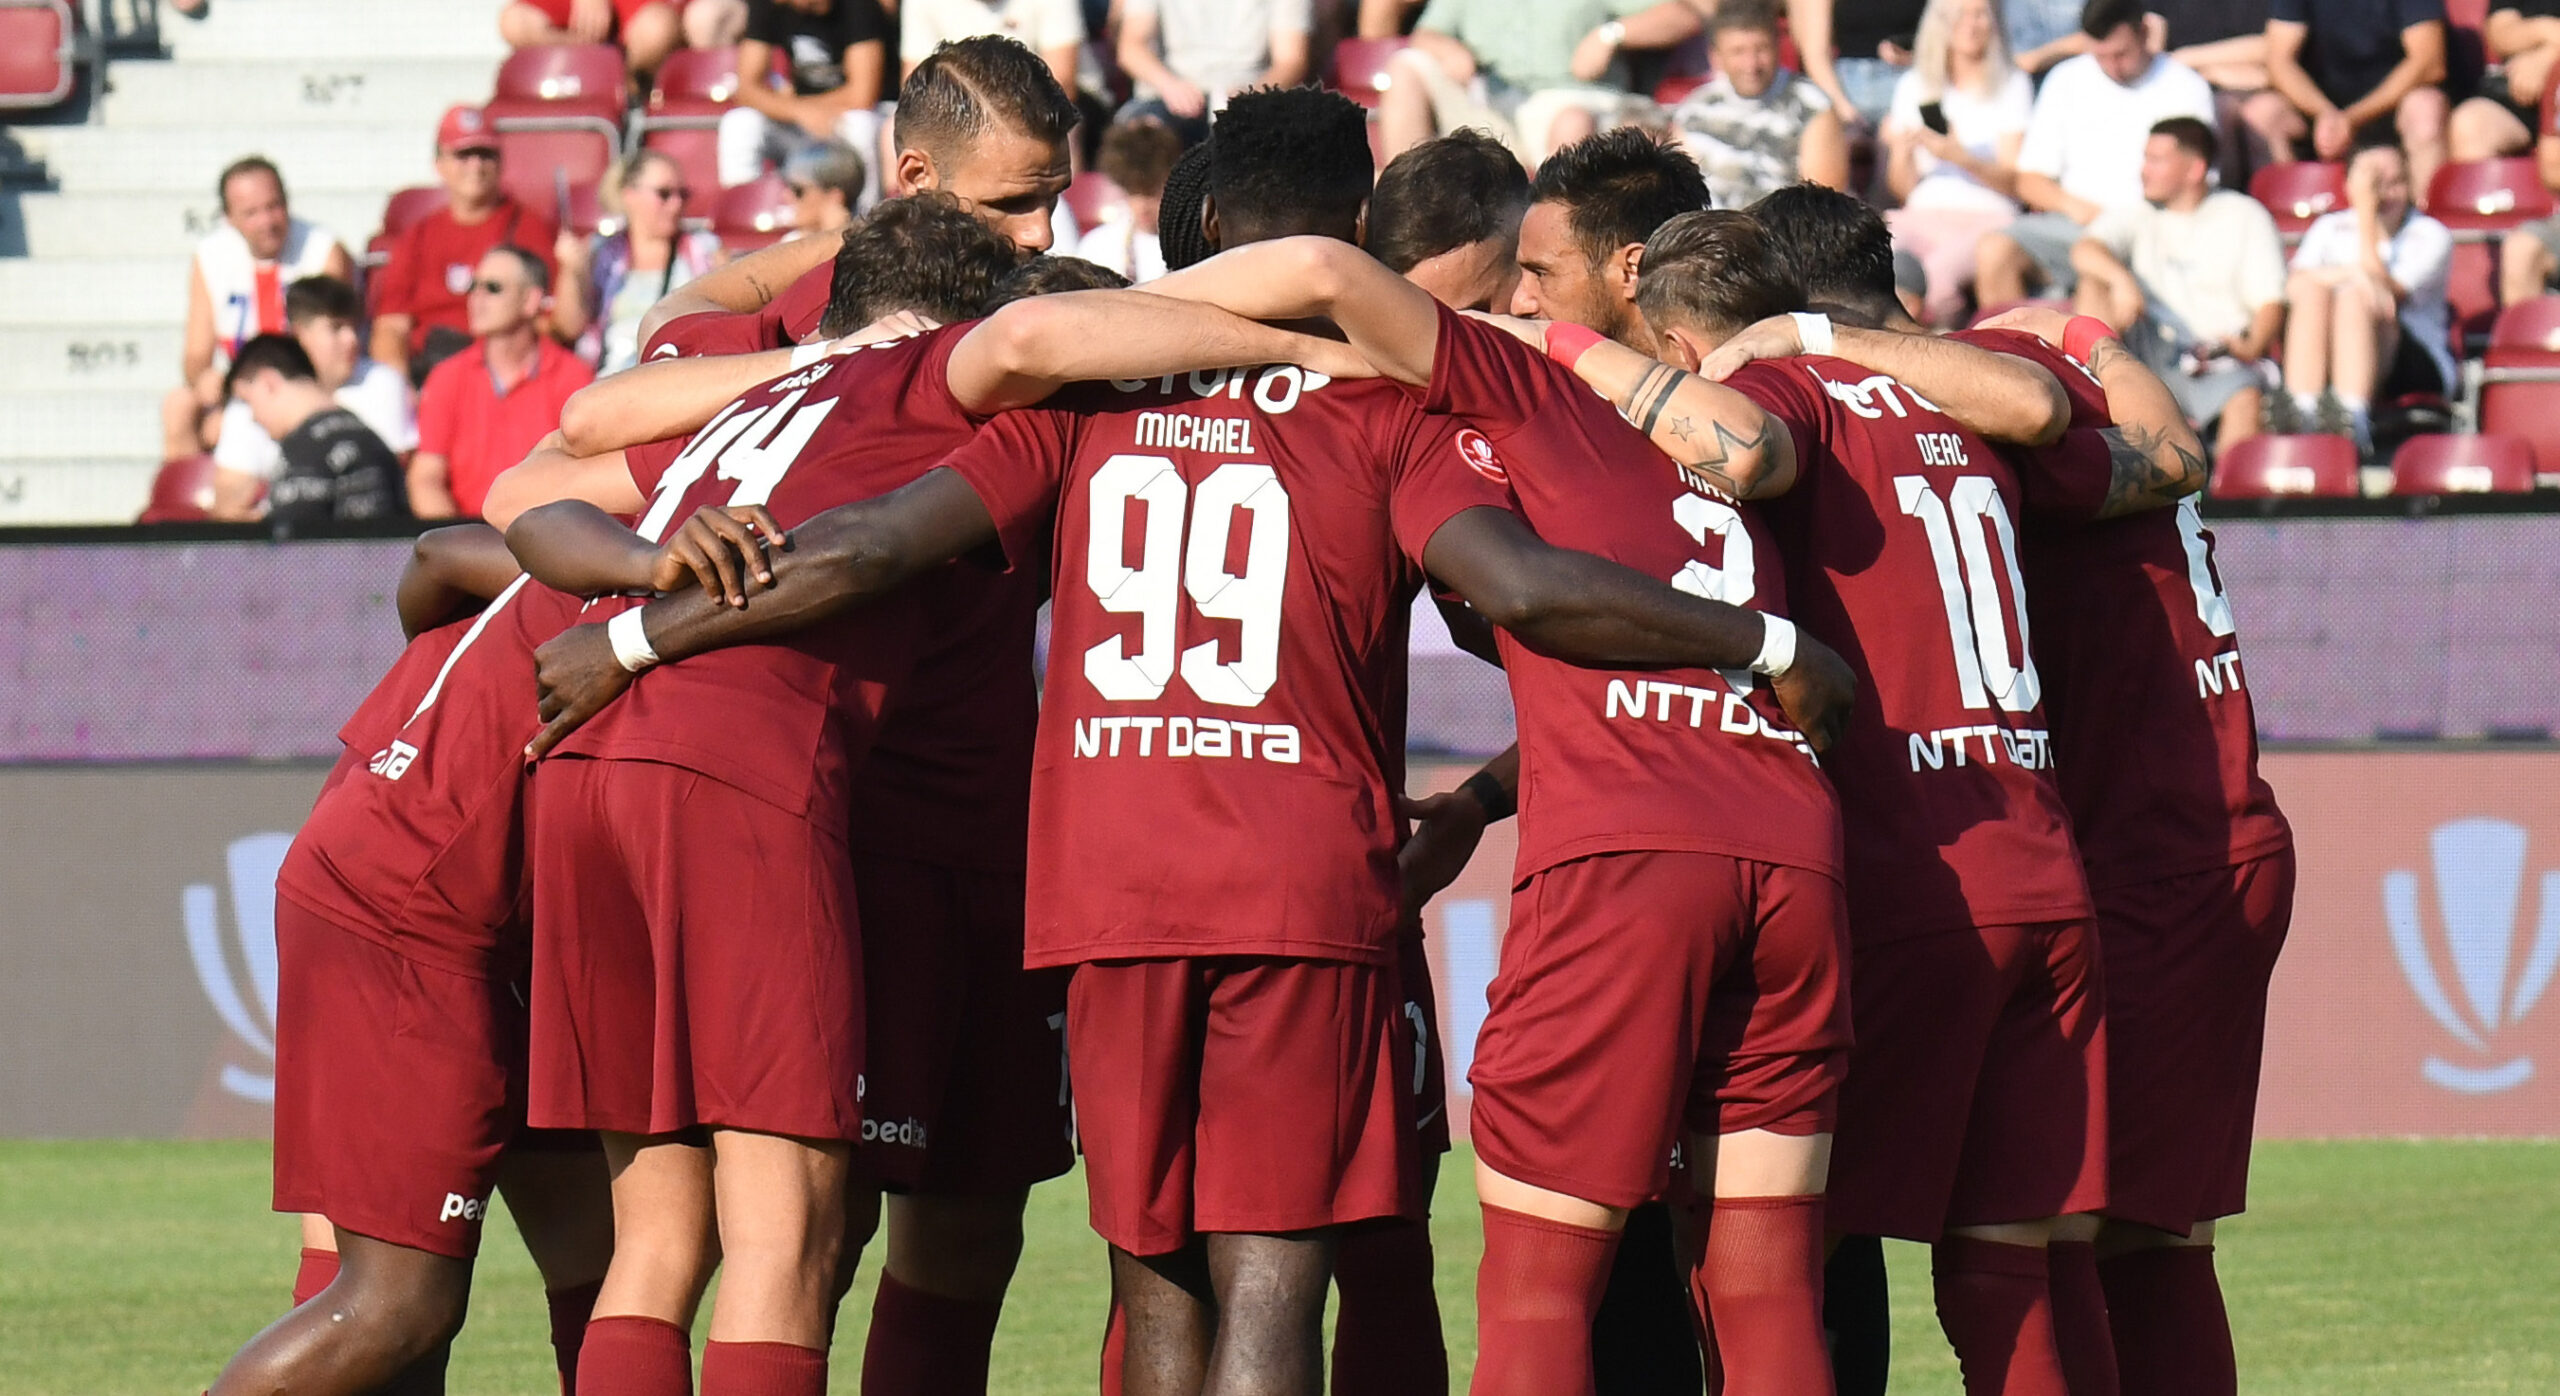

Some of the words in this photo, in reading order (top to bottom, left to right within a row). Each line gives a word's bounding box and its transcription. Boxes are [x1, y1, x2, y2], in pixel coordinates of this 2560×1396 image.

[1135, 412, 1255, 454] MICHAEL
[1914, 432, 1968, 467] DEAC
[636, 388, 840, 544] 44
[1085, 454, 1289, 707] 99
[1893, 475, 2041, 713] 10
[1605, 679, 1717, 728] NTT
[1074, 716, 1164, 758] NTT
[1908, 724, 1999, 772] NTT
